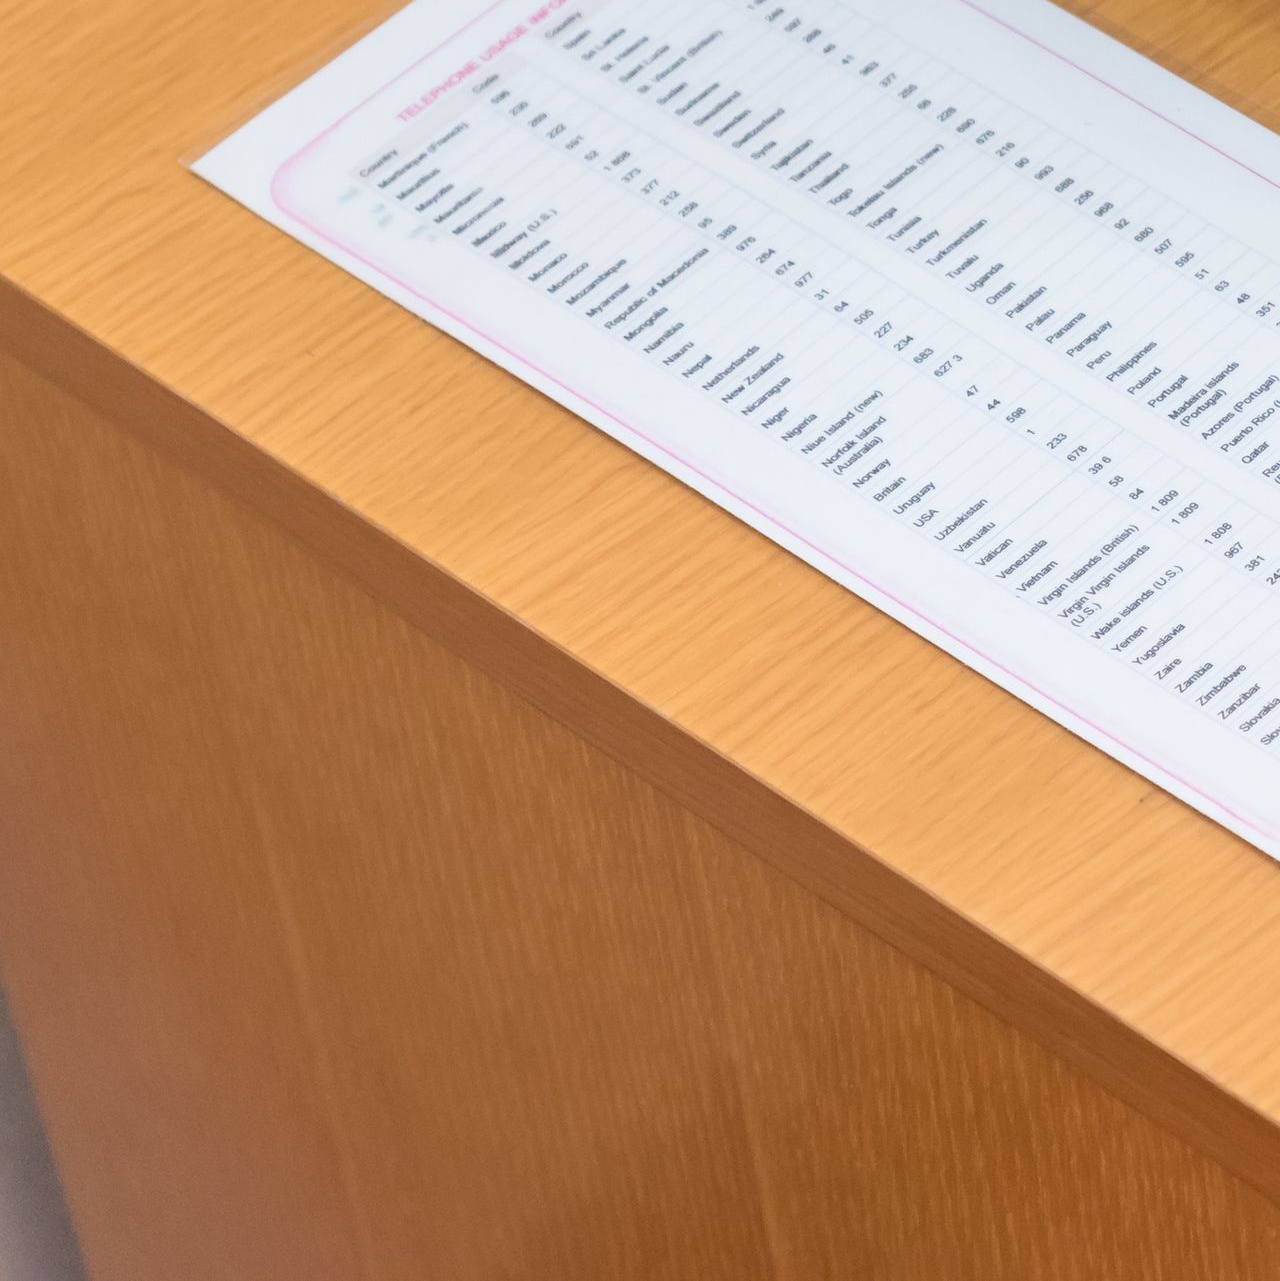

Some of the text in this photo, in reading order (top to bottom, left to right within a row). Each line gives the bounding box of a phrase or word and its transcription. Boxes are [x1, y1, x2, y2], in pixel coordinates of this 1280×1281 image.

[396, 61, 479, 120] TELEPHONE
[480, 24, 528, 61] USAGE
[1074, 189, 1094, 205] 256
[905, 229, 940, 253] Turkey
[1153, 238, 1172, 254] 507
[527, 253, 568, 281] Monaco
[755, 248, 776, 263] 264
[794, 271, 813, 287] 977
[965, 262, 1004, 292] Uganda
[1214, 279, 1230, 291] 63
[585, 282, 630, 317] Myanmar
[985, 281, 1016, 304] Oman
[853, 308, 874, 324] 505
[1255, 301, 1276, 317] 351
[643, 322, 684, 353] Namibia
[1045, 312, 1087, 344] Panama
[681, 353, 713, 378] Nepal
[1106, 341, 1157, 382] Philippines
[740, 376, 791, 416] Nicaragua
[966, 384, 978, 396] 47
[1147, 374, 1189, 408] Portugal
[987, 398, 1001, 410] 44
[852, 458, 891, 487] Norway
[873, 476, 906, 501] Britain
[892, 481, 936, 514] Uruguay
[1196, 664, 1247, 706] Zimbabwe
